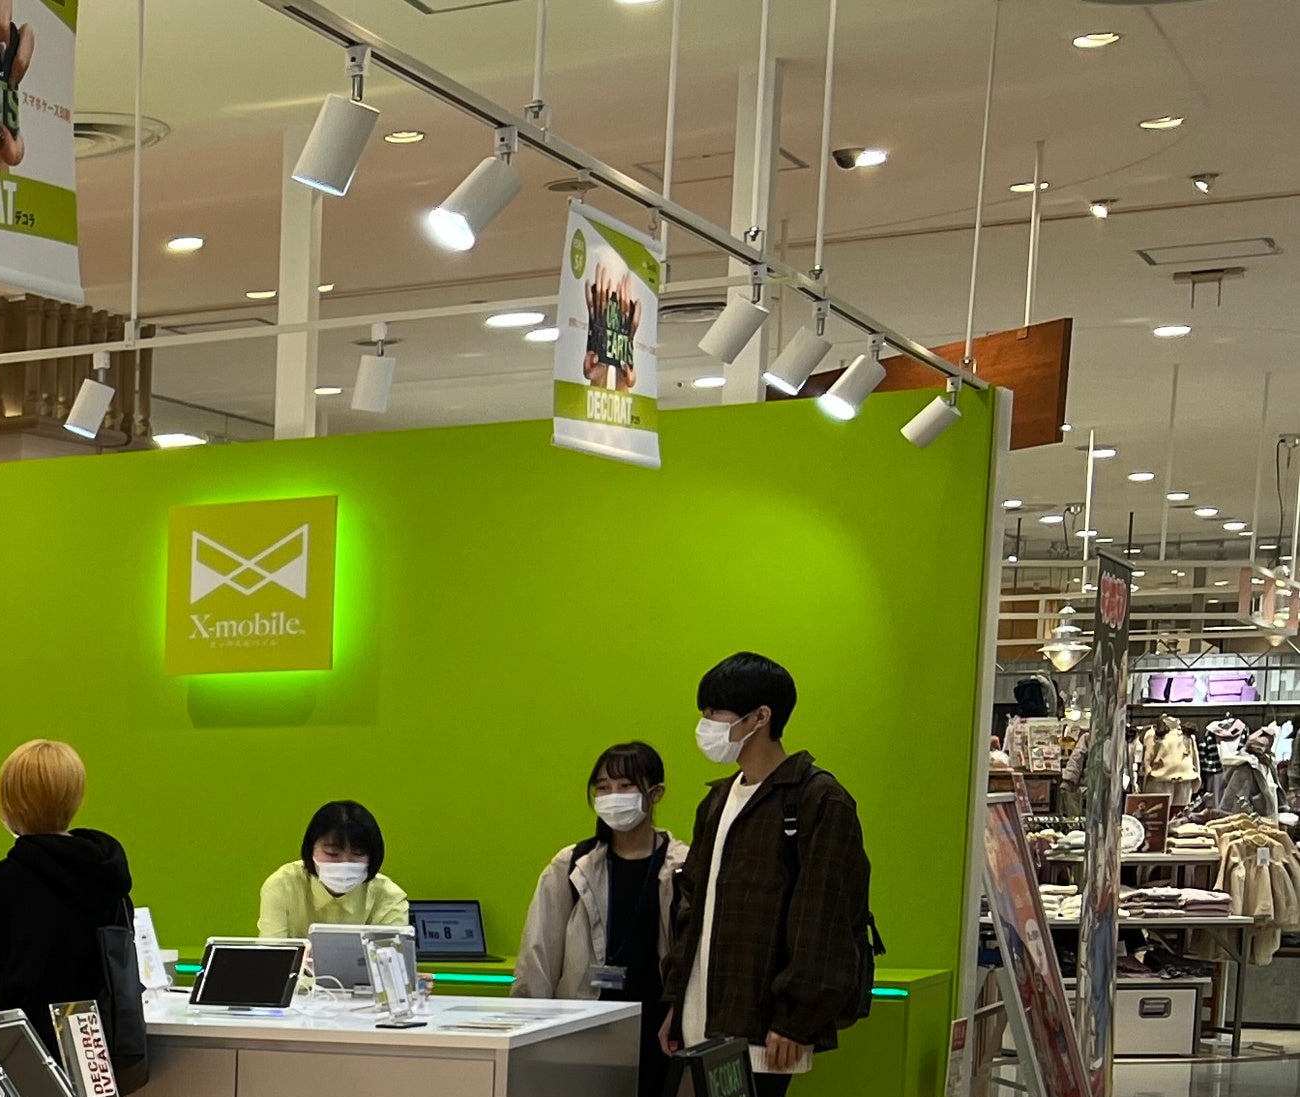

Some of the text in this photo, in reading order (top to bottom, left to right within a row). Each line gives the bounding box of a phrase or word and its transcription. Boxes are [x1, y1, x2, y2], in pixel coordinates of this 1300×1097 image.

[14, 210, 36, 228] デコラ
[586, 389, 633, 425] DECORAT
[76, 1015, 105, 1096] DECORAT
[87, 1012, 115, 1094] IVEARTS
